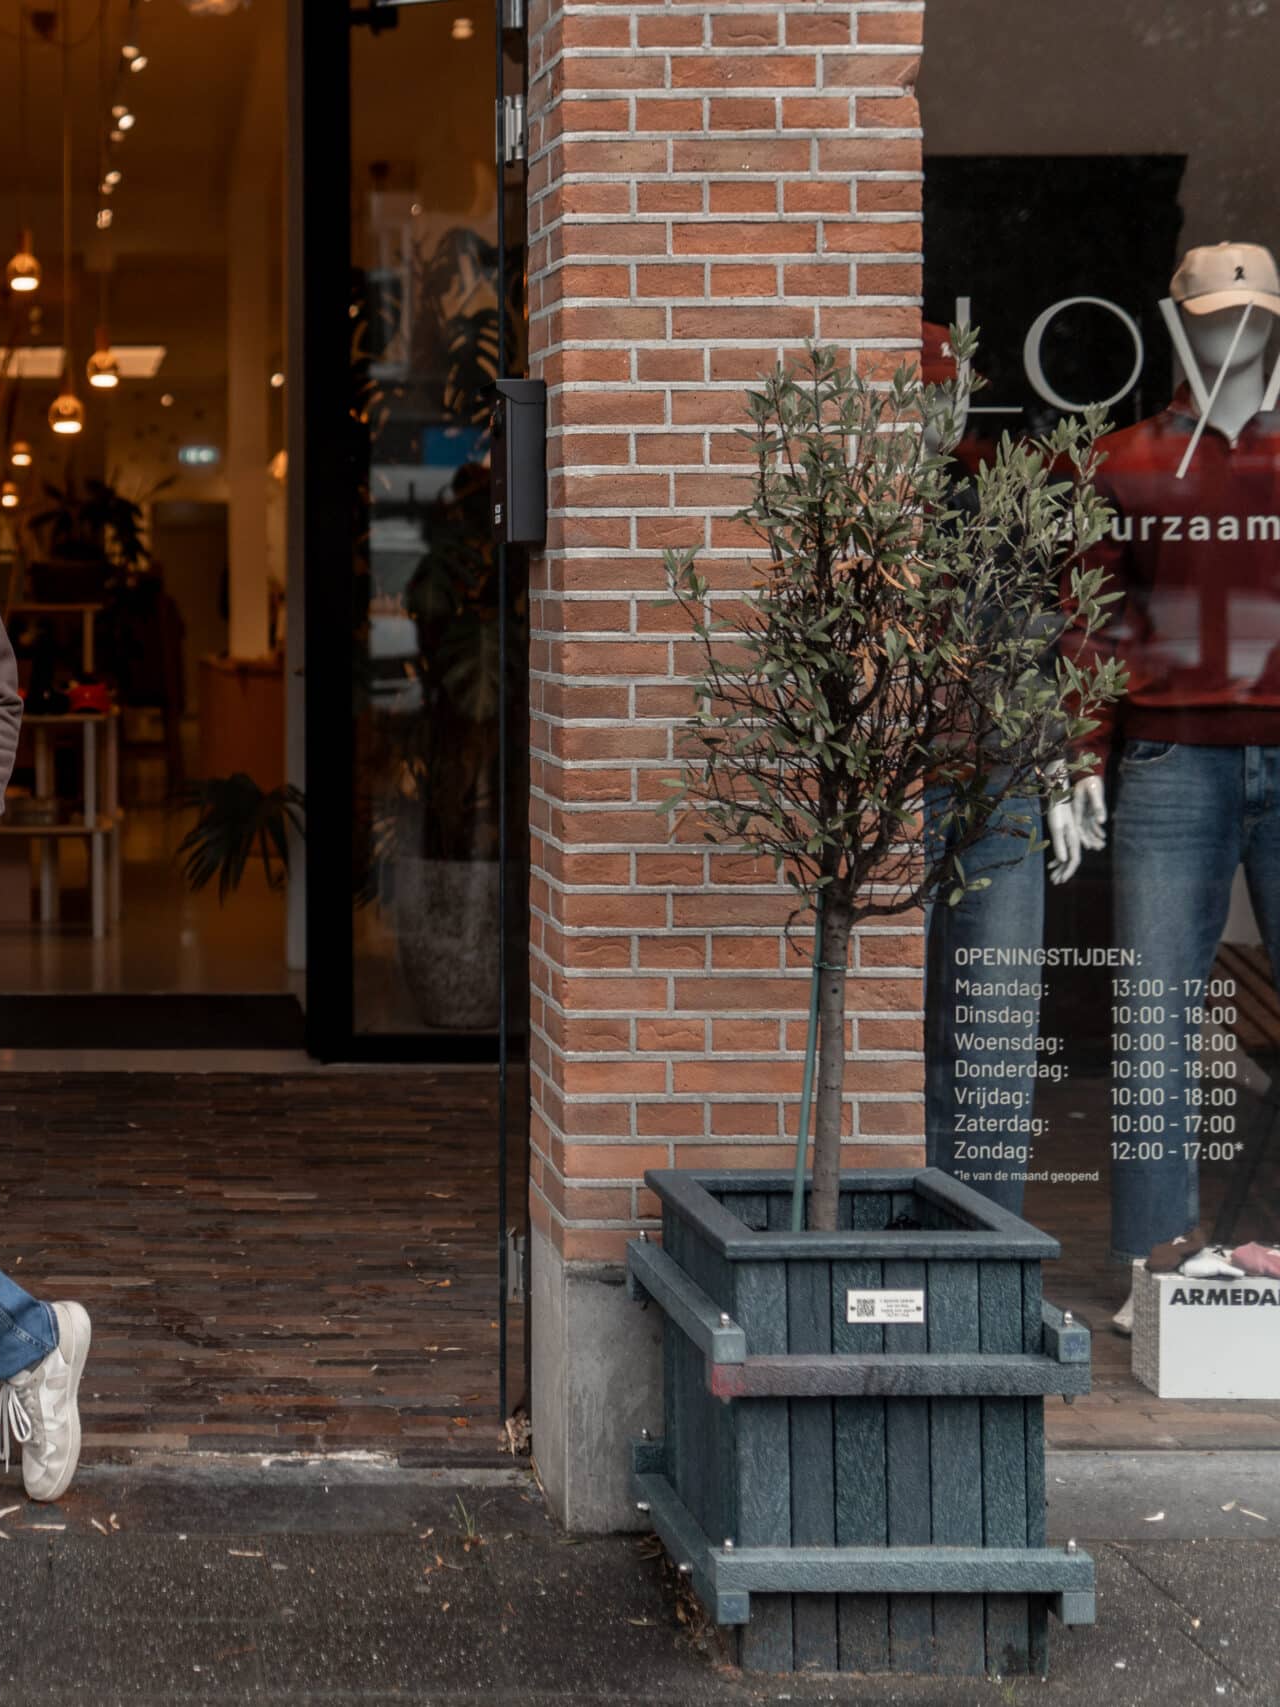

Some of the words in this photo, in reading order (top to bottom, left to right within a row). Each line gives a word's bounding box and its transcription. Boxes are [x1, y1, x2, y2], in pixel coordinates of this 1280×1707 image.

[956, 296, 1280, 479] LOY
[1056, 511, 1280, 542] urzaam
[954, 948, 1143, 967] OPENINGSTIJDEN:
[954, 979, 1050, 1000] Maandag:
[1111, 979, 1165, 997] 13:00
[1182, 979, 1236, 997] 17:00
[954, 1006, 1041, 1028] Dinsdag:
[1111, 1006, 1165, 1024] 10:00
[1182, 1006, 1238, 1024] 18:00
[954, 1033, 1064, 1055] Woensdag:
[1111, 1033, 1165, 1051] 10:00
[1182, 1033, 1238, 1051] 18:00
[954, 1060, 1069, 1082] Donderdag:
[1111, 1060, 1165, 1078] 10:00
[1182, 1060, 1238, 1078] 18:00
[954, 1087, 1030, 1109] Vrijdag:
[1111, 1087, 1165, 1106] 10:00
[1182, 1087, 1238, 1106] 18:00
[954, 1114, 1050, 1136] Zaterdag:
[1111, 1115, 1165, 1133] 10:00
[1182, 1115, 1236, 1133] 17:00
[953, 1141, 1035, 1163] Zondag:
[1111, 1141, 1165, 1160] 12:00
[972, 1171, 993, 1181] van
[994, 1170, 1009, 1181] de
[1010, 1170, 1049, 1181] maand
[1050, 1170, 1100, 1183] geopend
[1169, 1287, 1280, 1306] ARMEDA
